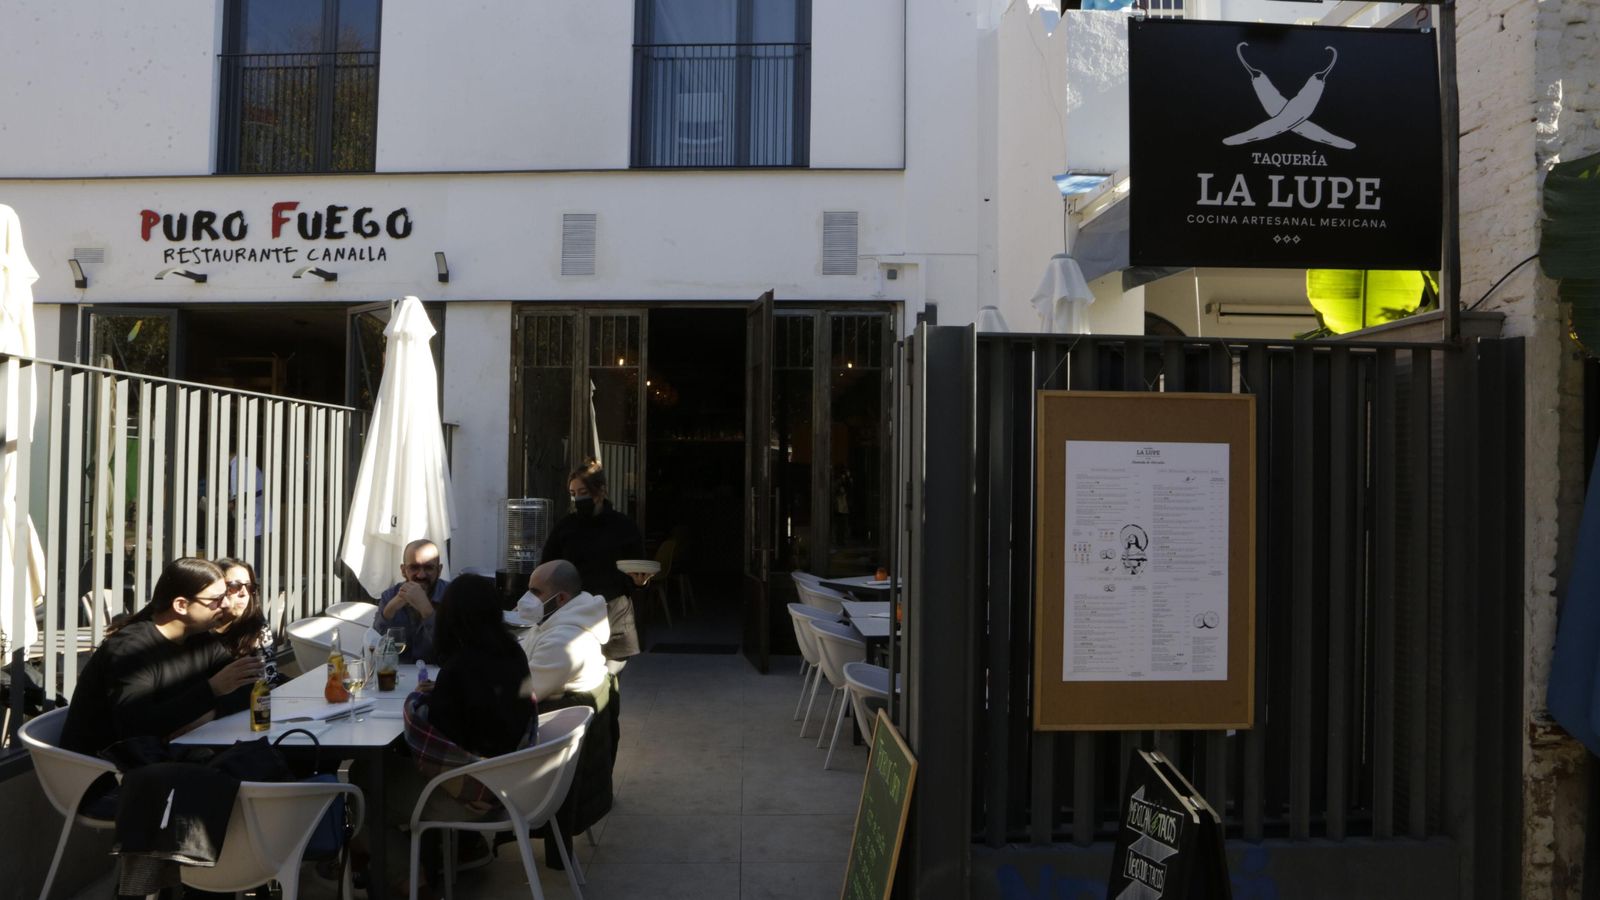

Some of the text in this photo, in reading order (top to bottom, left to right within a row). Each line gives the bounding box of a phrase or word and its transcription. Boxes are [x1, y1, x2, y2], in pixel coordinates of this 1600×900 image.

[1252, 150, 1328, 167] TAQUERÍA
[1196, 172, 1382, 211] LA LUPE
[139, 201, 413, 242] PURO FUEGO
[1186, 214, 1387, 229] COCINA ARTESANAL MEXICANA
[163, 245, 387, 265] RESTAURANTE CANALLA
[1156, 812, 1177, 844] TACOS
